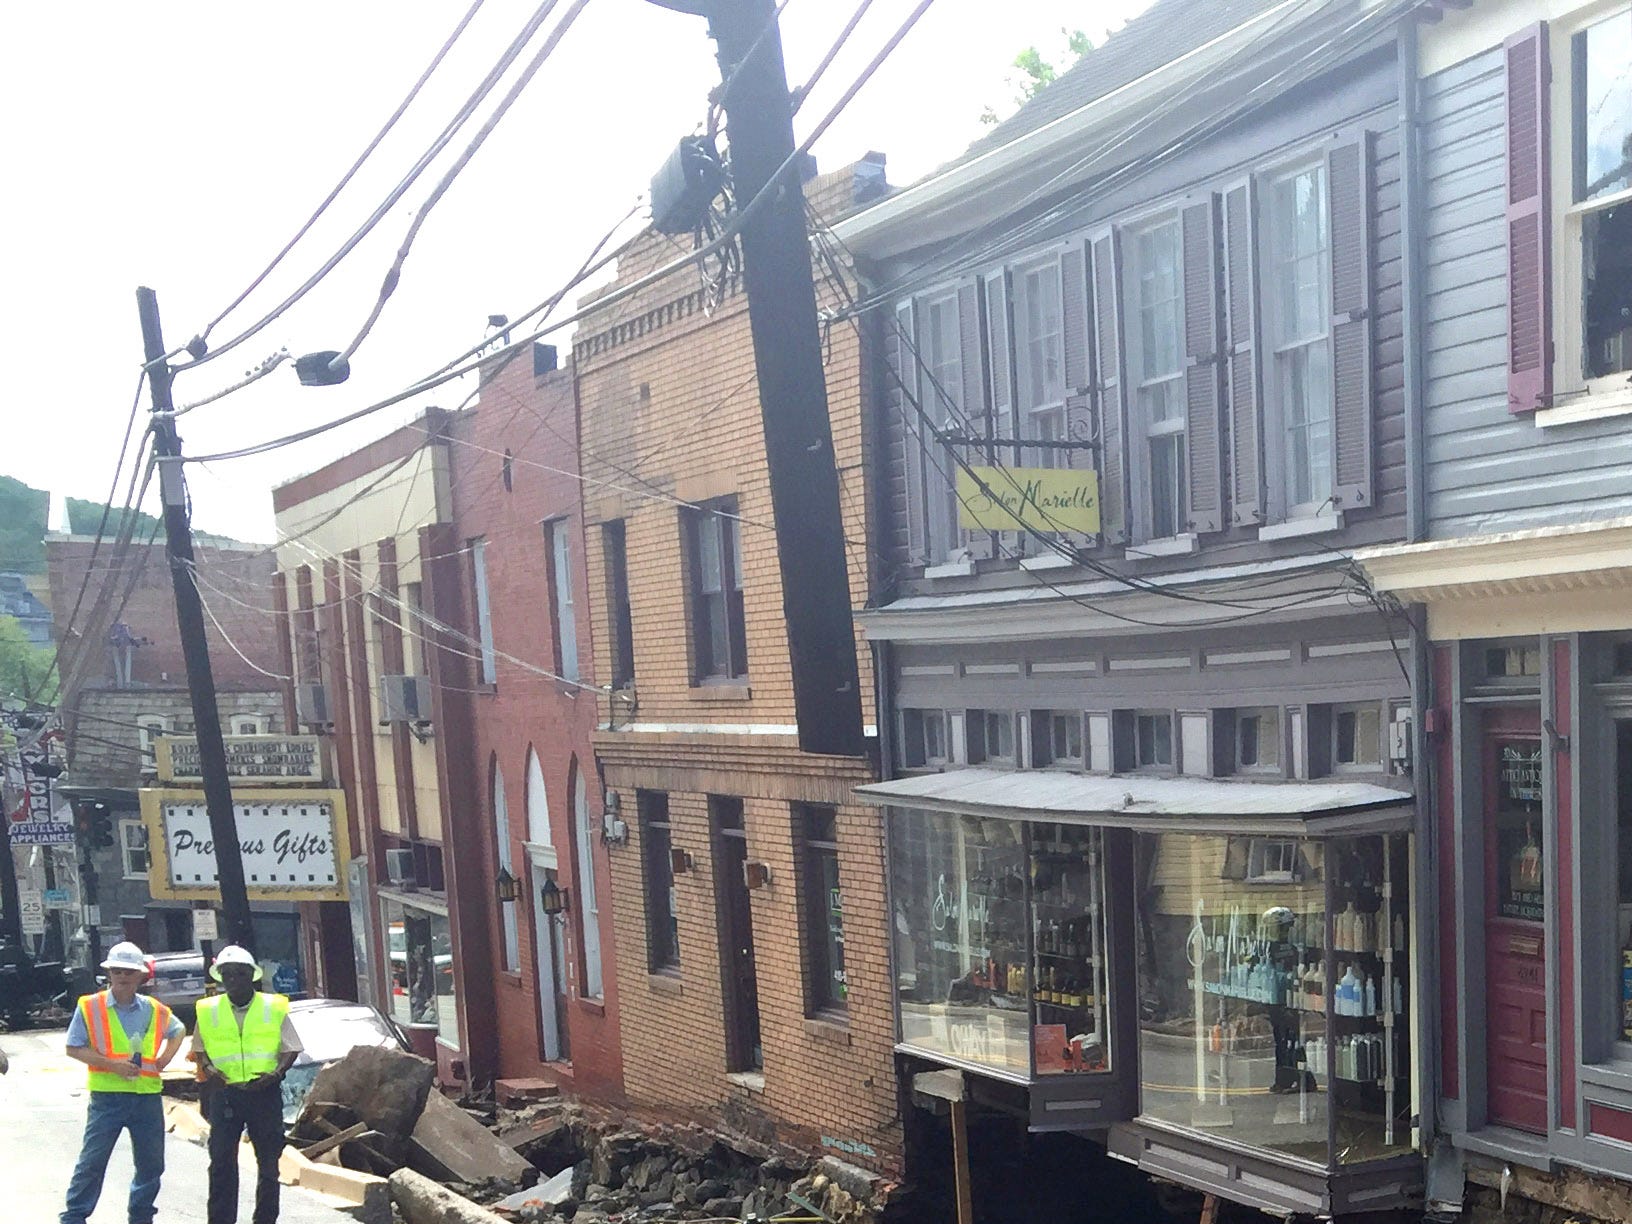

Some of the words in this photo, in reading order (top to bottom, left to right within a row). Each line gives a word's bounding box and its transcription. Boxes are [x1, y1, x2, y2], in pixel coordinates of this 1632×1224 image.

[1018, 479, 1095, 517] Marielle
[8, 823, 69, 836] JEWELRY
[10, 833, 76, 844] APPLIANCES
[173, 829, 266, 858] Preus
[272, 829, 329, 865] Gifts
[23, 902, 41, 912] 25
